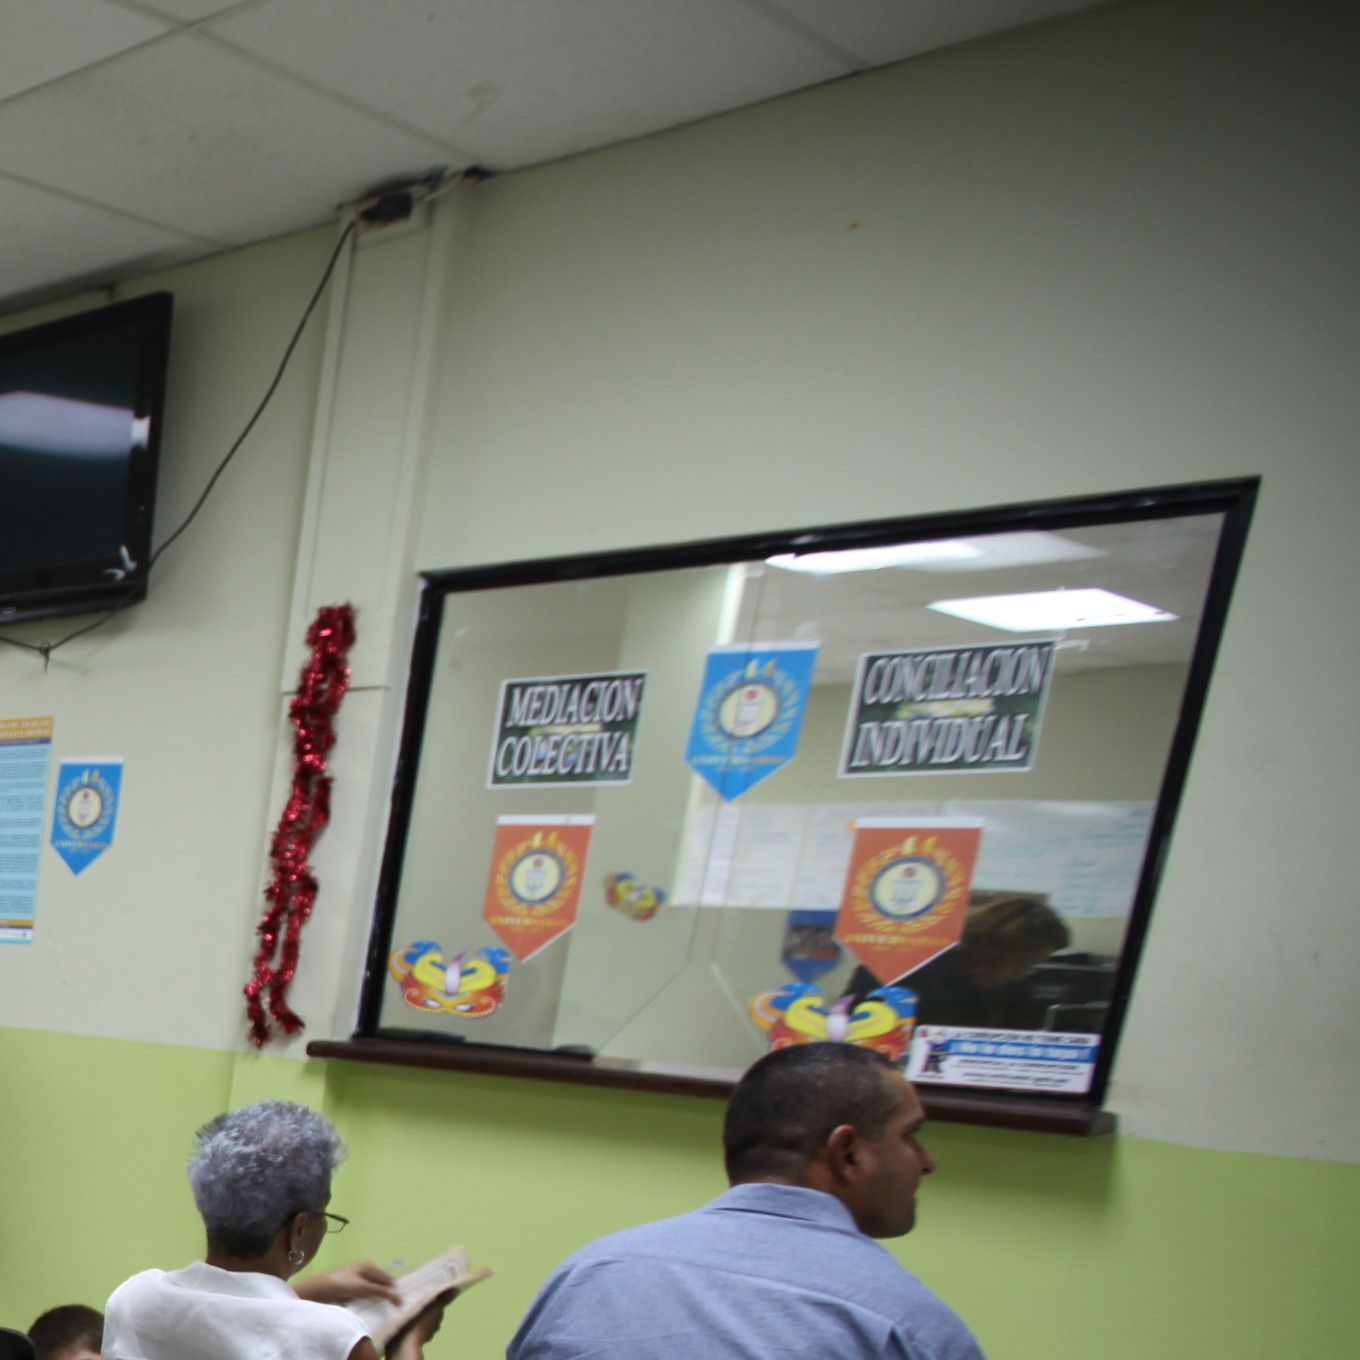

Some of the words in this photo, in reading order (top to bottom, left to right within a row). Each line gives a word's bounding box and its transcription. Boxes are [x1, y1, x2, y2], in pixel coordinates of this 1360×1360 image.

[864, 646, 1053, 705] CONCILIACION
[506, 678, 644, 727] MEDIACION
[496, 731, 630, 777] COLECTIVA
[849, 713, 1030, 767] INDIVIDUAL
